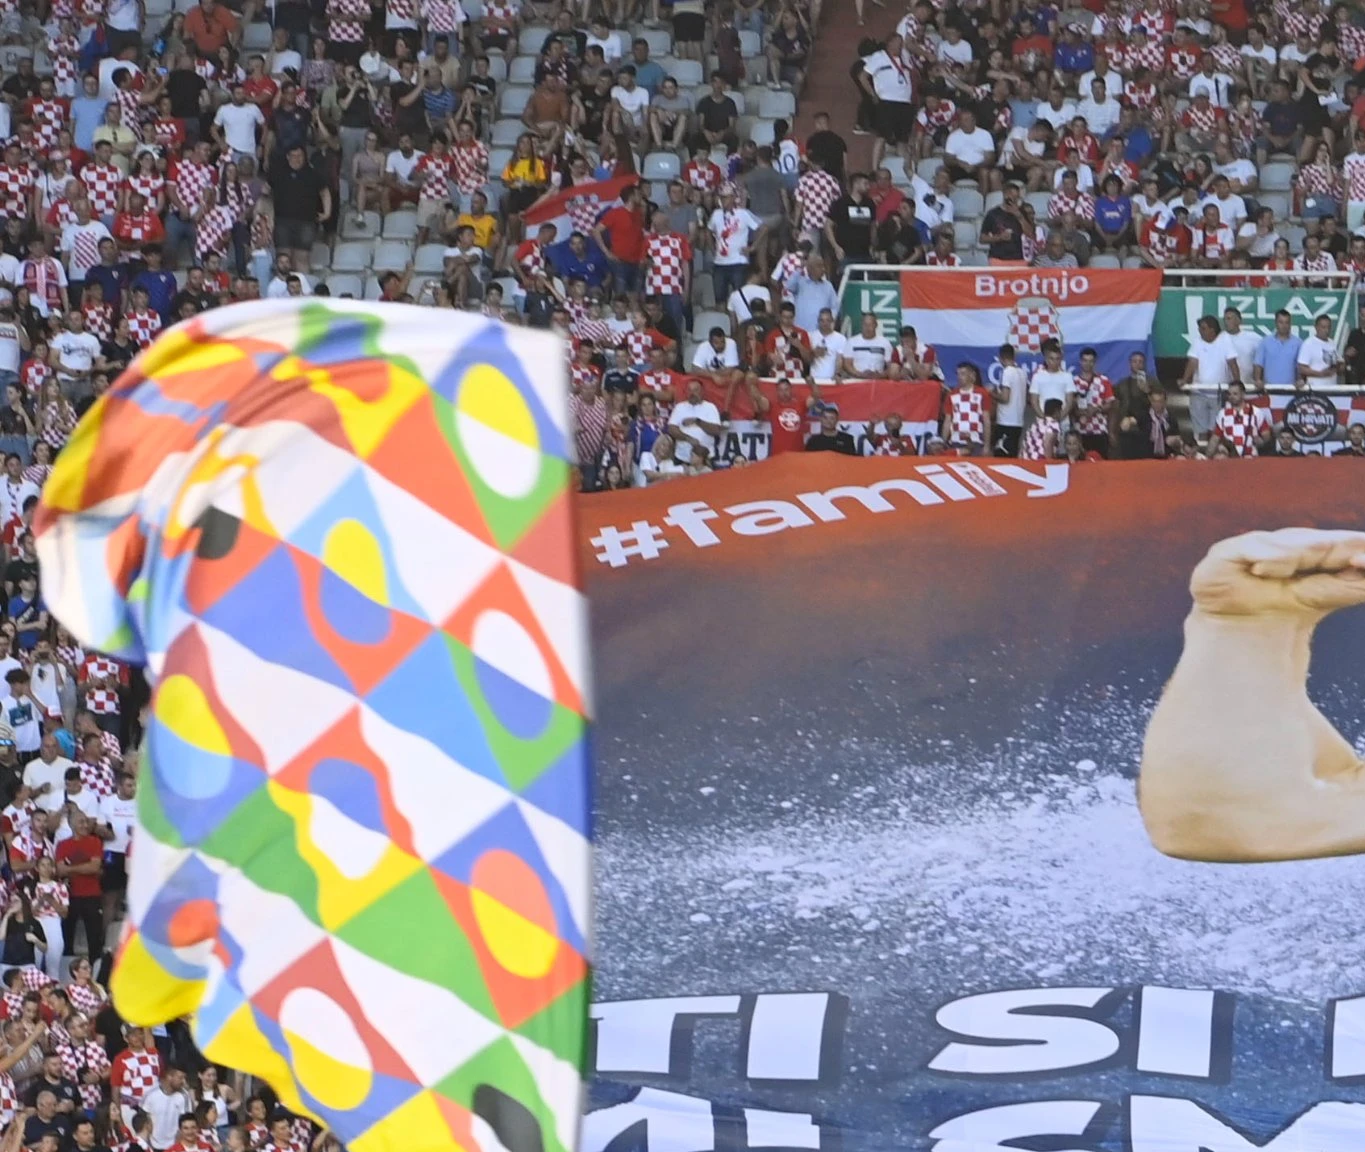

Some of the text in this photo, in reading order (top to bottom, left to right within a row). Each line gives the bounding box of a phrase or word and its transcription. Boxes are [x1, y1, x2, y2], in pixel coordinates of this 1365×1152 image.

[976, 271, 1089, 299] Brotnjo
[1218, 296, 1339, 319] IZLAZ
[590, 461, 1069, 568] #family
[589, 991, 831, 1081] TI
[925, 984, 1216, 1077] SI
